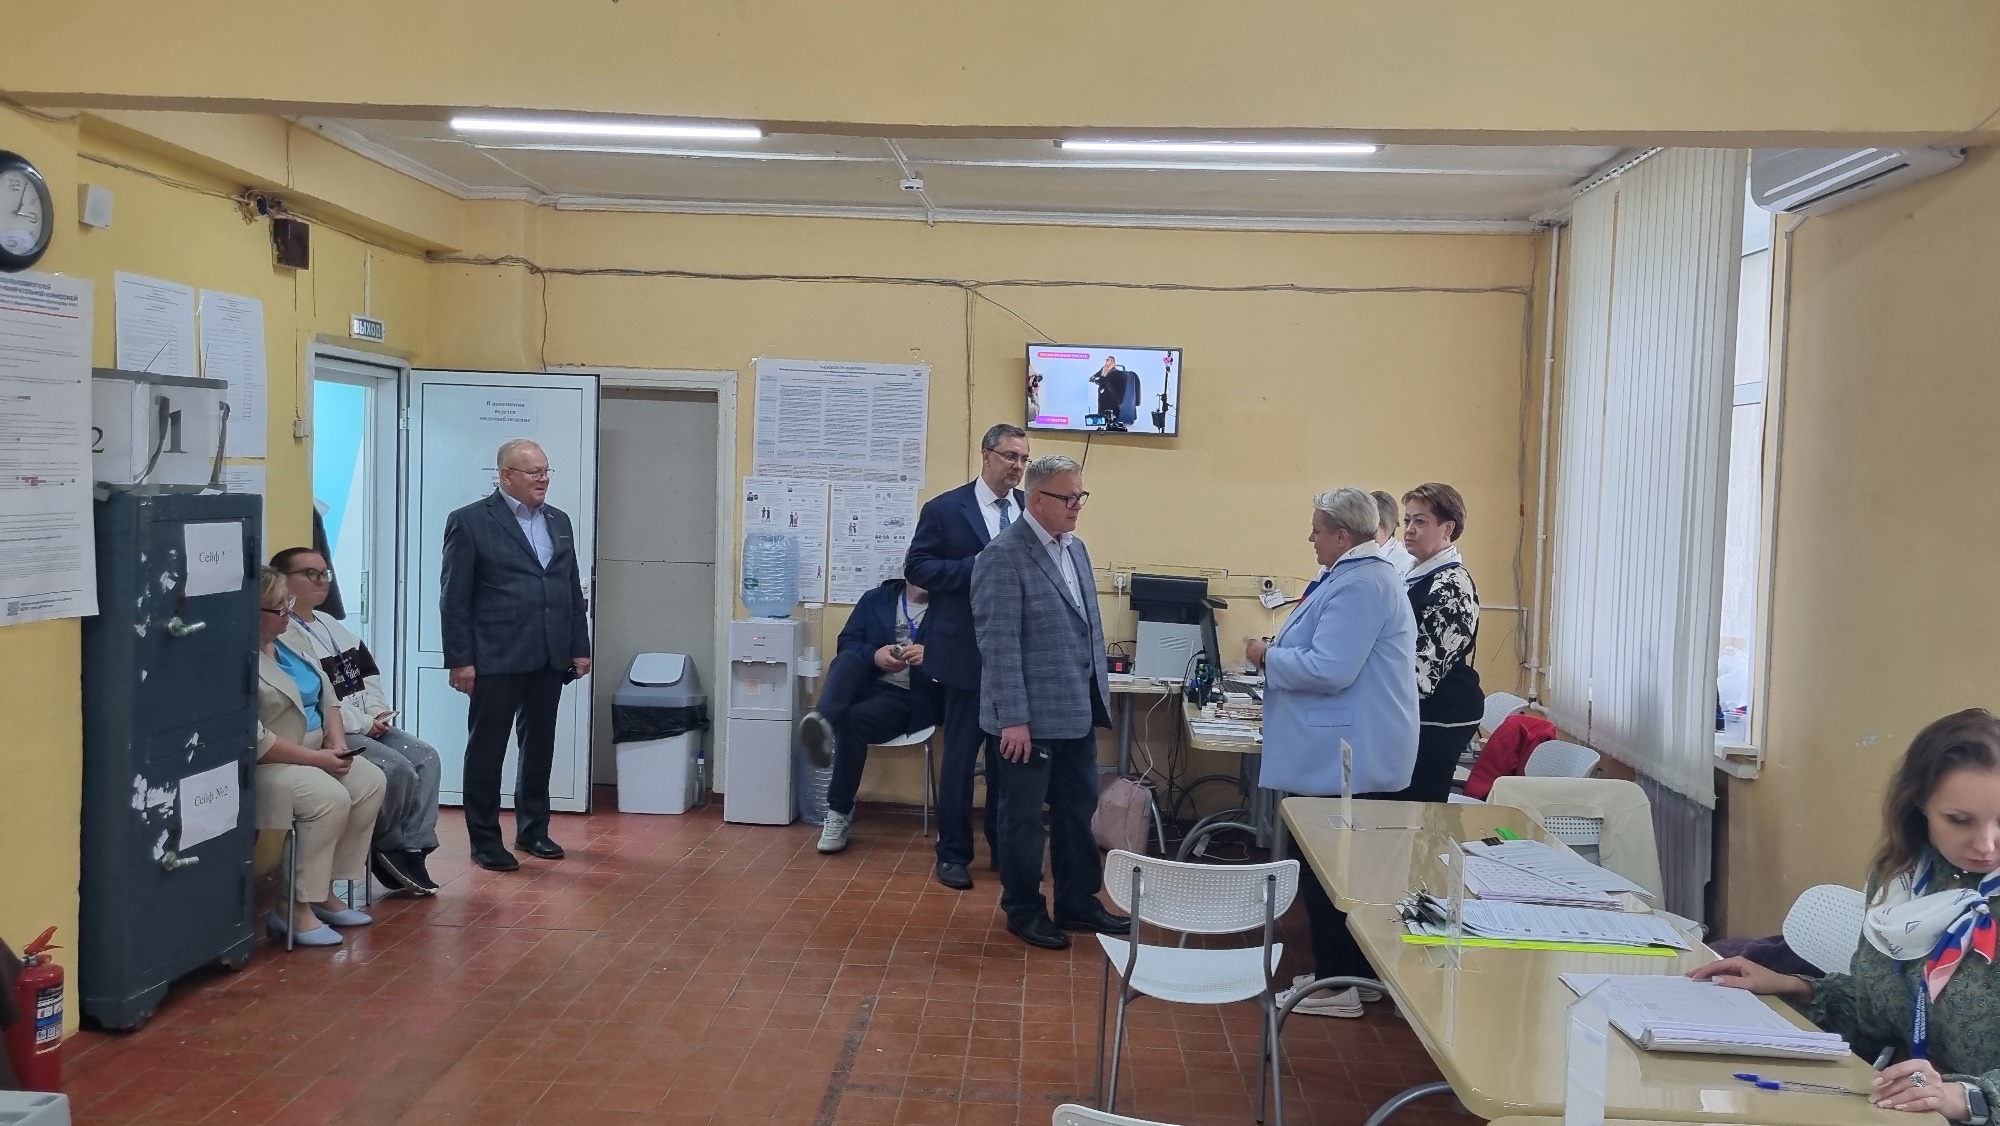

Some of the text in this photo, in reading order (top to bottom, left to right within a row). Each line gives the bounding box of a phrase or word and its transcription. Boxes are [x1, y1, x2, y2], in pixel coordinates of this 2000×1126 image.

[354, 320, 381, 338] ВЫХОД
[164, 410, 188, 454] 1
[198, 550, 220, 564] Сейф
[194, 786, 229, 806] Сейф №2
